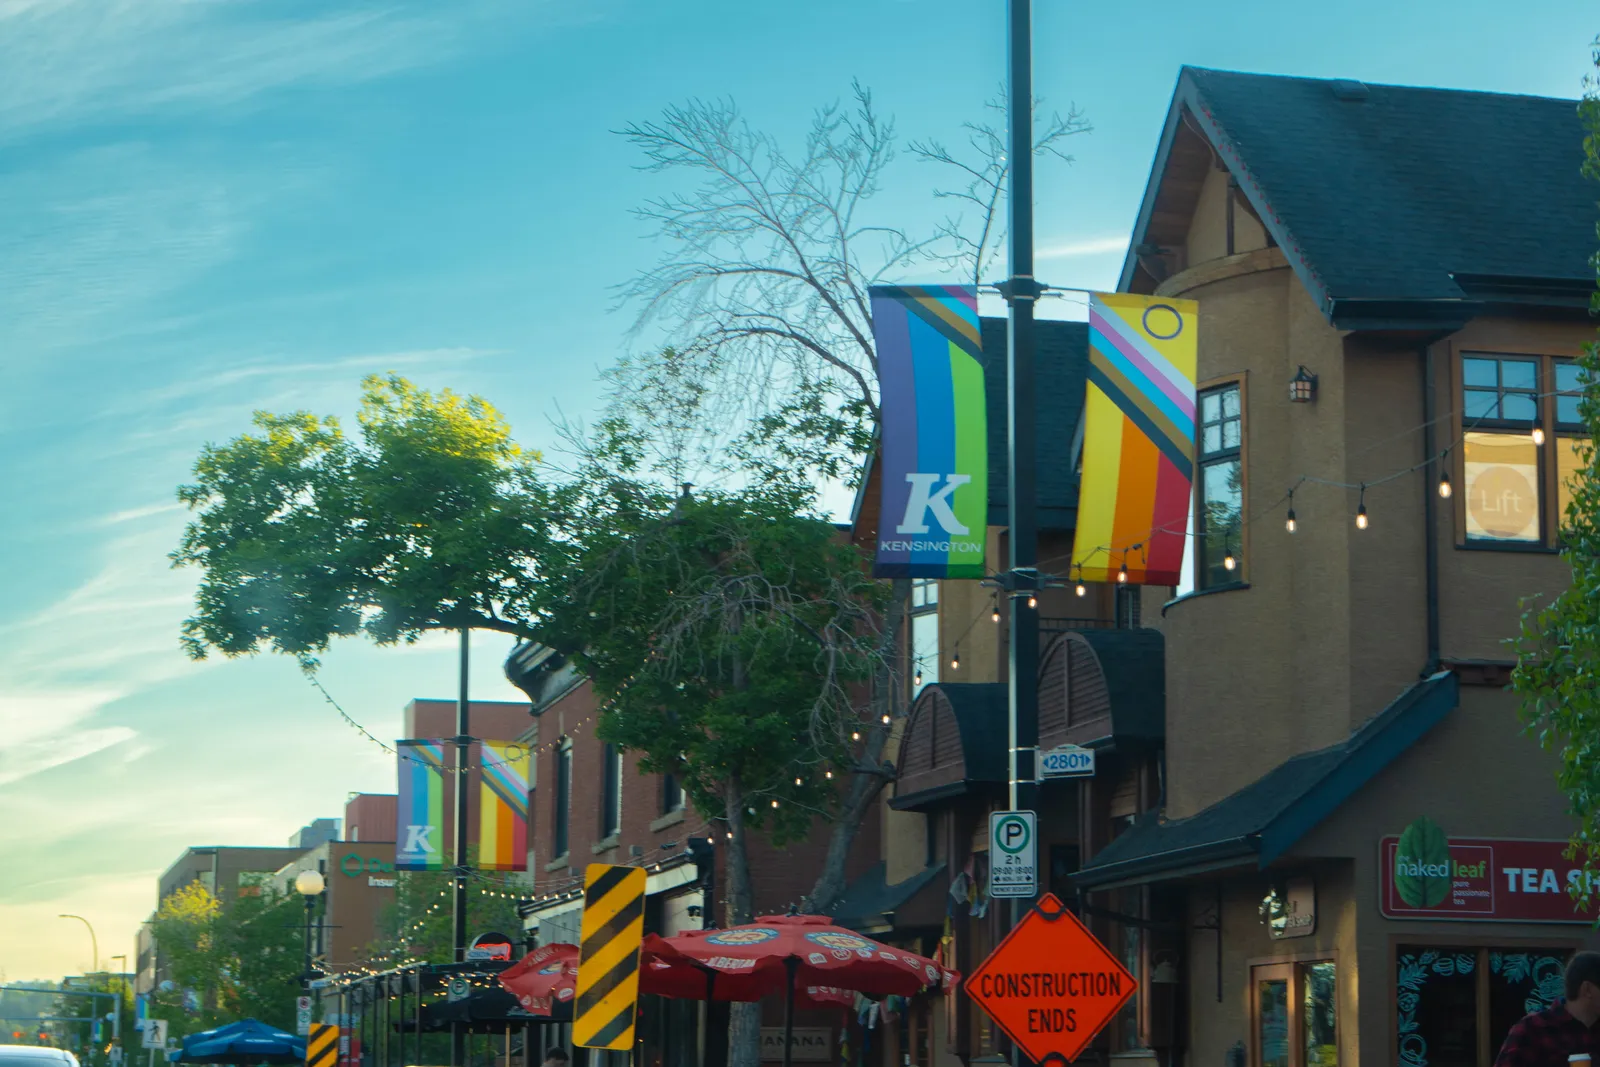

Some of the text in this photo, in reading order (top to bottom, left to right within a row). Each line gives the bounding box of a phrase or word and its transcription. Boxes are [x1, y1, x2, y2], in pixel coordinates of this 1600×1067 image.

[896, 473, 971, 535] K
[1481, 489, 1522, 516] Lift
[881, 540, 981, 553] KENSINGTON
[1049, 753, 1086, 770] 2801
[403, 825, 436, 853] K
[1005, 823, 1023, 846] P
[1397, 858, 1486, 878] naked leaf
[1452, 881, 1470, 889] pure
[1502, 867, 1561, 894] TEA
[1452, 889, 1491, 898] passionate
[981, 972, 1121, 998] CONSTRUCTION
[1027, 1008, 1077, 1034] ENDS
[760, 1032, 826, 1047] AÑANA
